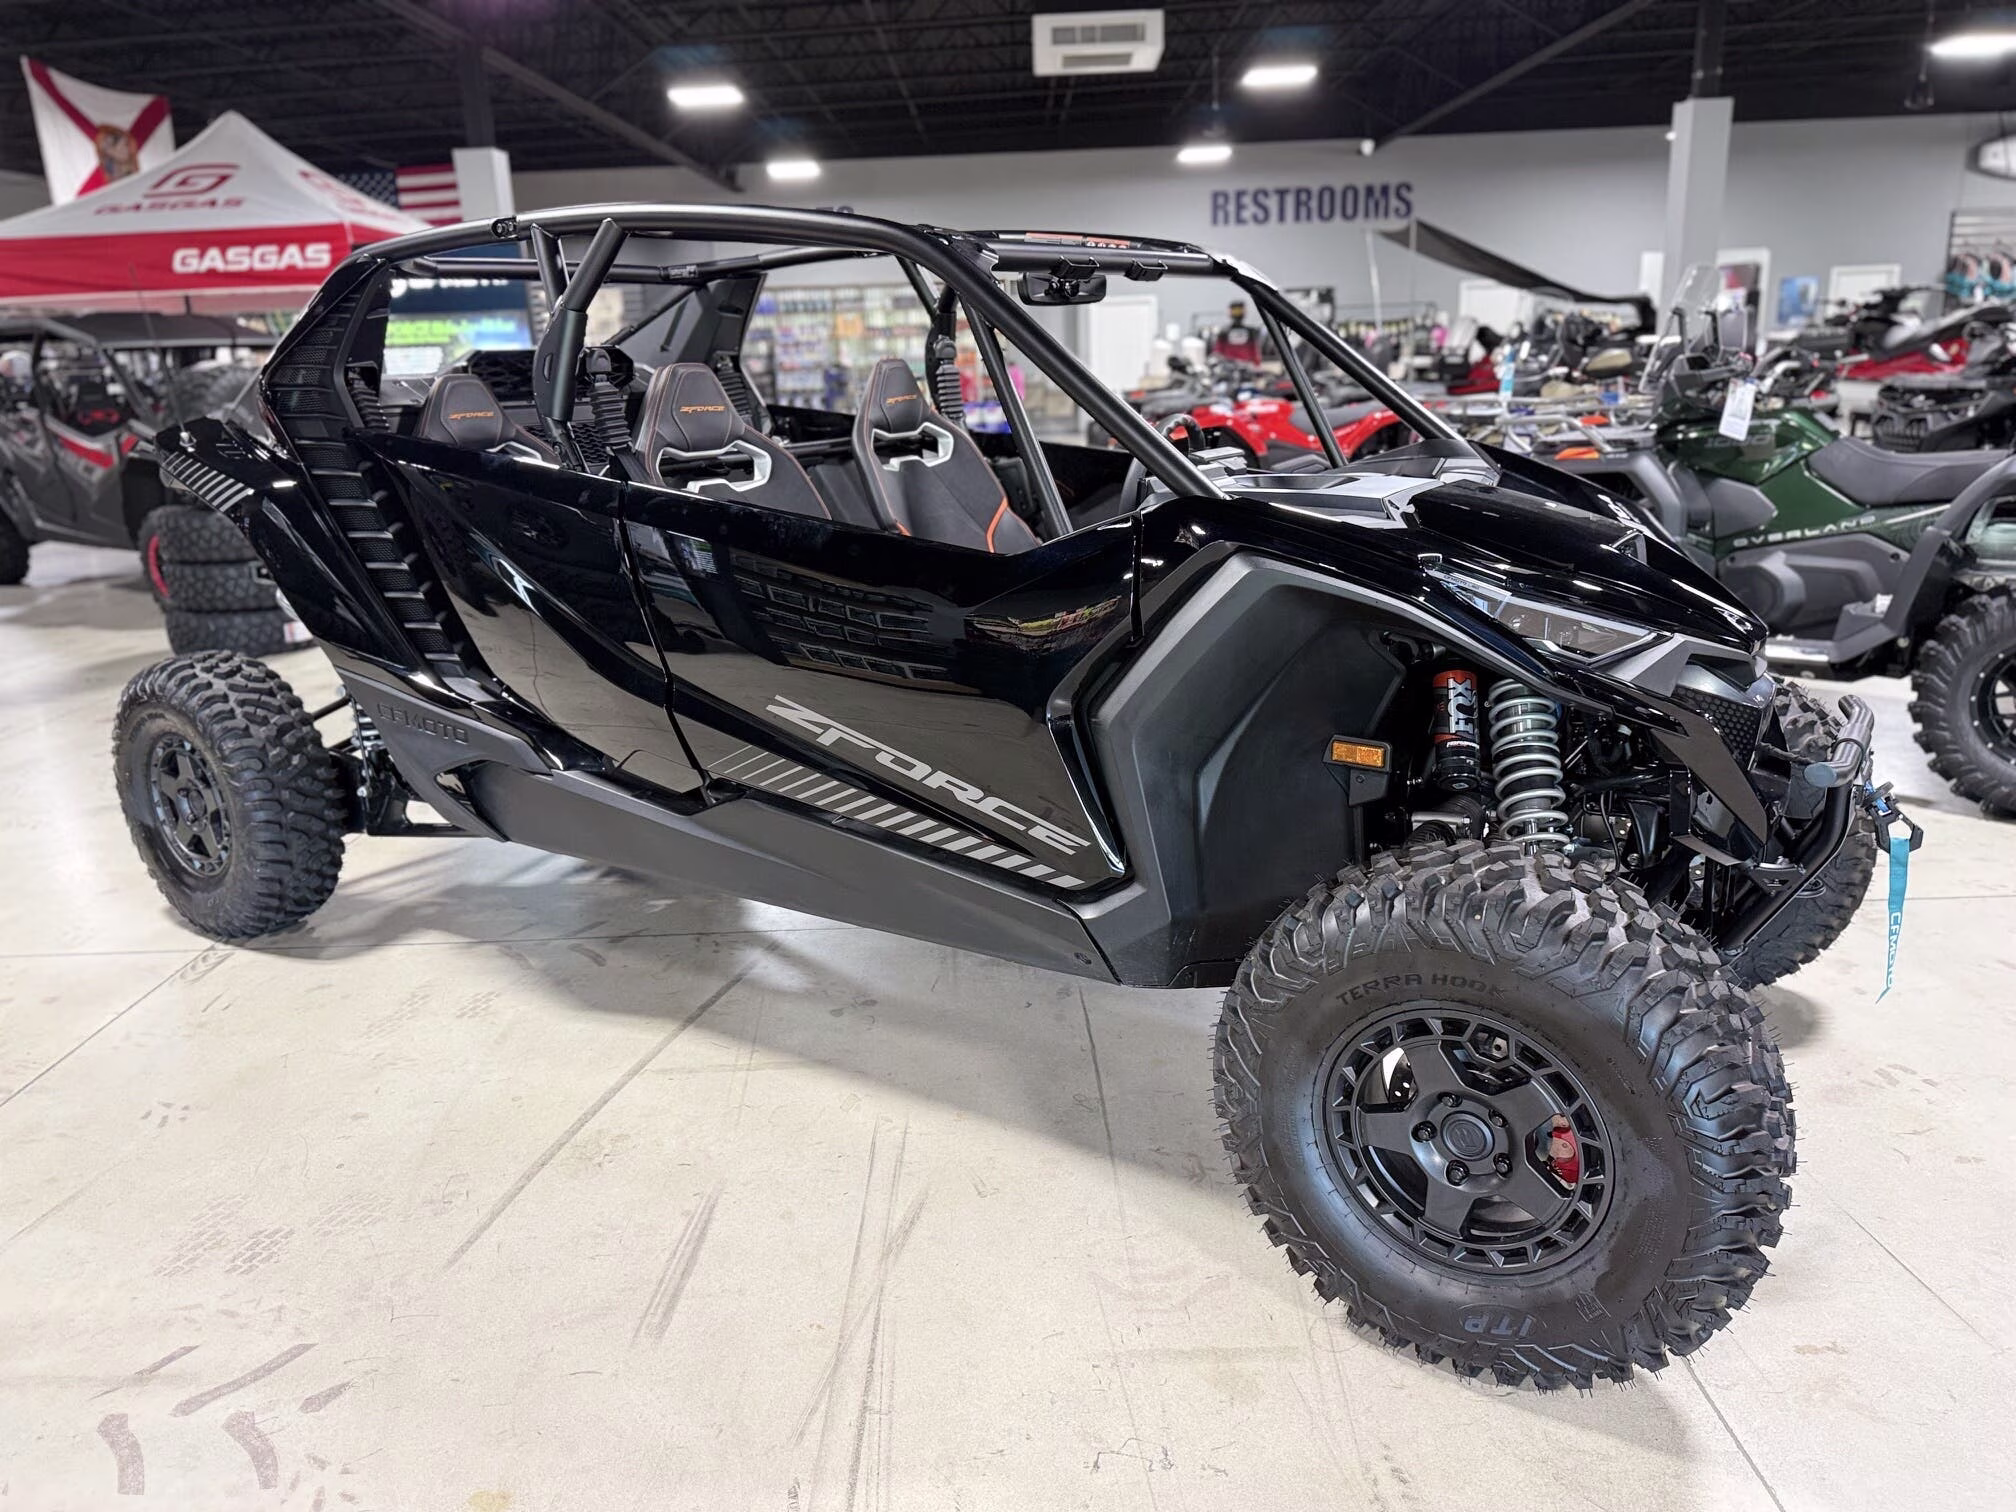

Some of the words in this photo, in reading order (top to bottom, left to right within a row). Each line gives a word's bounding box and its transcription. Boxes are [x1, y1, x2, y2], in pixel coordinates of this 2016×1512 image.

[1211, 182, 1415, 227] RESTROOMS
[172, 242, 332, 275] GASGAS
[1733, 515, 1876, 547] OVERLAND
[377, 703, 468, 745] CFMOTO
[766, 694, 1092, 856] ZFORCE
[1336, 973, 1423, 1006] TERRA
[1431, 973, 1506, 1000] HOOK
[1464, 1313, 1533, 1338] ITP
